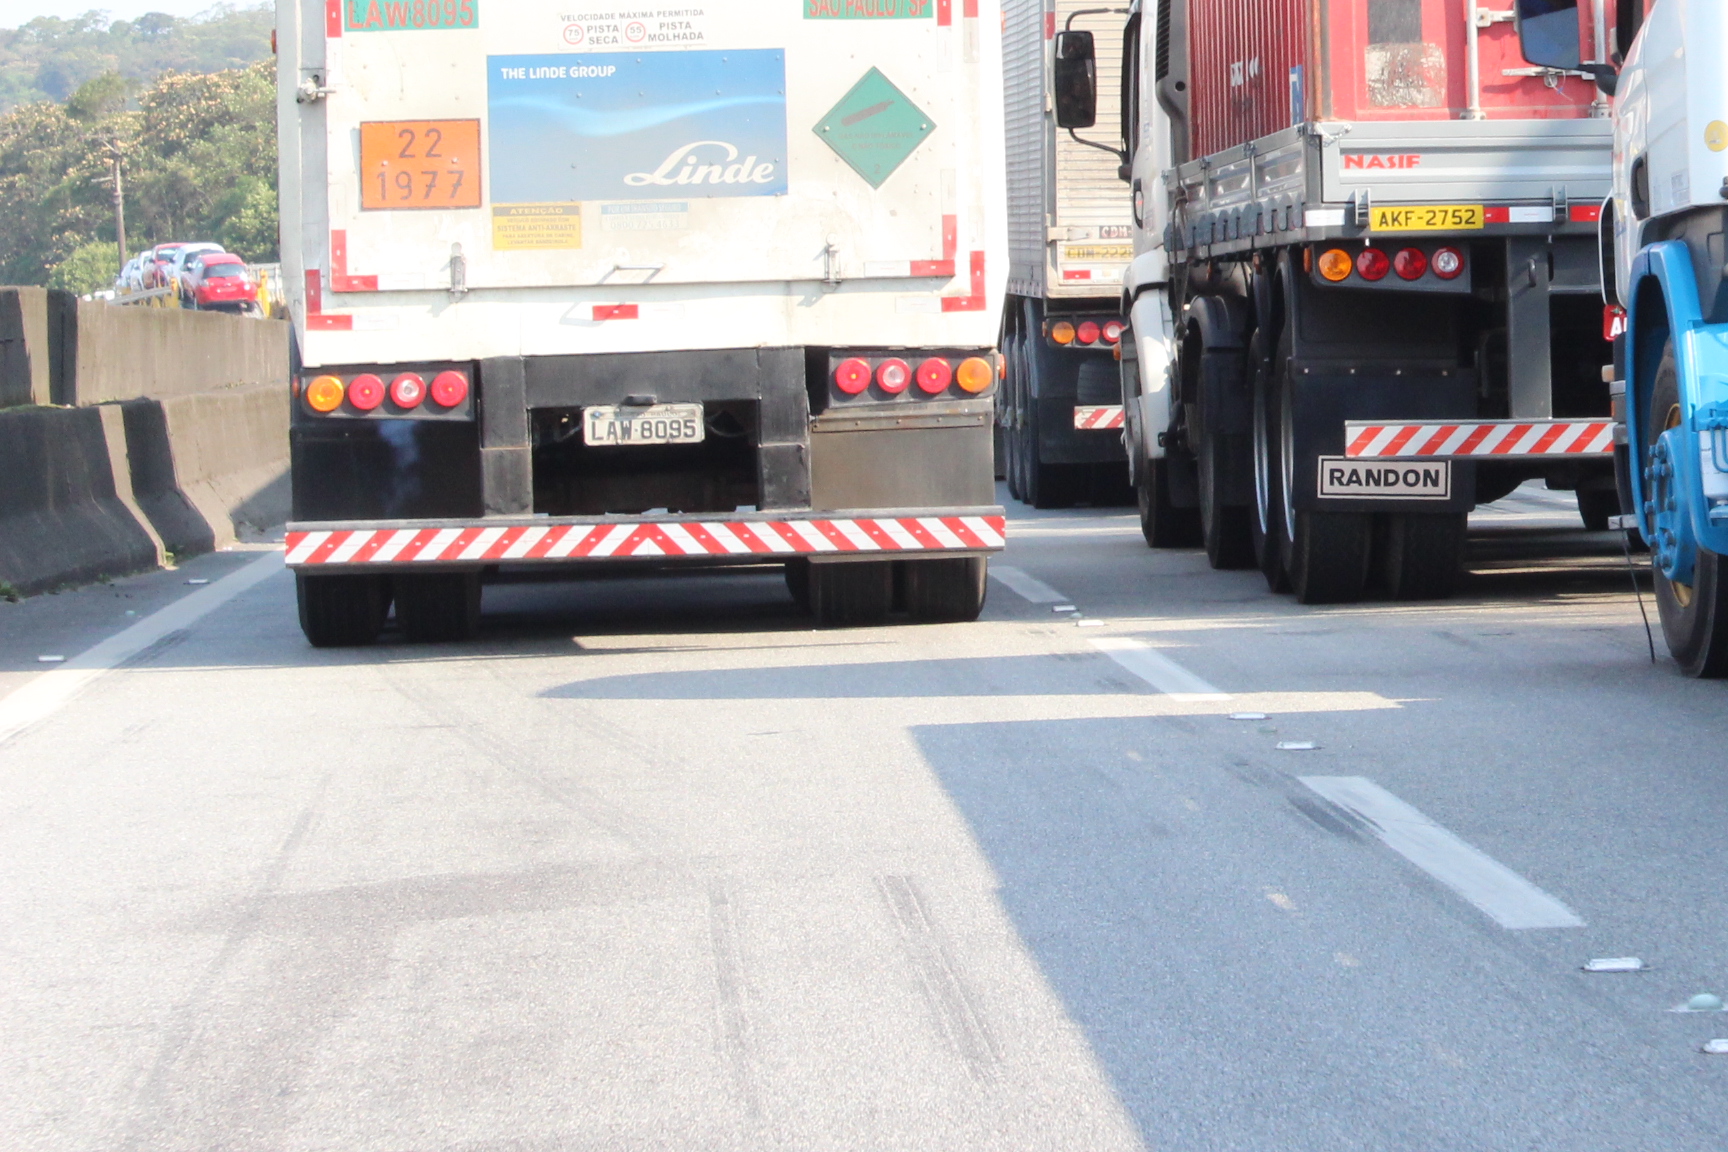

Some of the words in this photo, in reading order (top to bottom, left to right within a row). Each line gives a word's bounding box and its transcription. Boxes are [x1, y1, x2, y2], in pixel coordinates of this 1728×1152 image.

[561, 12, 616, 22] VELOCIDADE
[619, 10, 654, 19] MÁXIMA
[657, 9, 704, 18] PERMITIDA
[587, 25, 619, 34] PISTA
[630, 26, 642, 34] 55
[659, 21, 692, 30] PISTA
[568, 29, 580, 37] 75
[648, 31, 704, 42] MOLHADA
[588, 36, 618, 45] SECA
[501, 67, 526, 79] THE
[529, 66, 567, 79] LINDE
[570, 65, 616, 78] GROUP
[399, 129, 442, 159] 22
[624, 140, 776, 187] Linde
[1344, 154, 1421, 169] NASIF
[376, 170, 465, 201] 1977
[510, 207, 563, 215] ATENÇÃO
[1379, 209, 1476, 227] AKF-2752
[1329, 468, 1440, 487] RANDON
